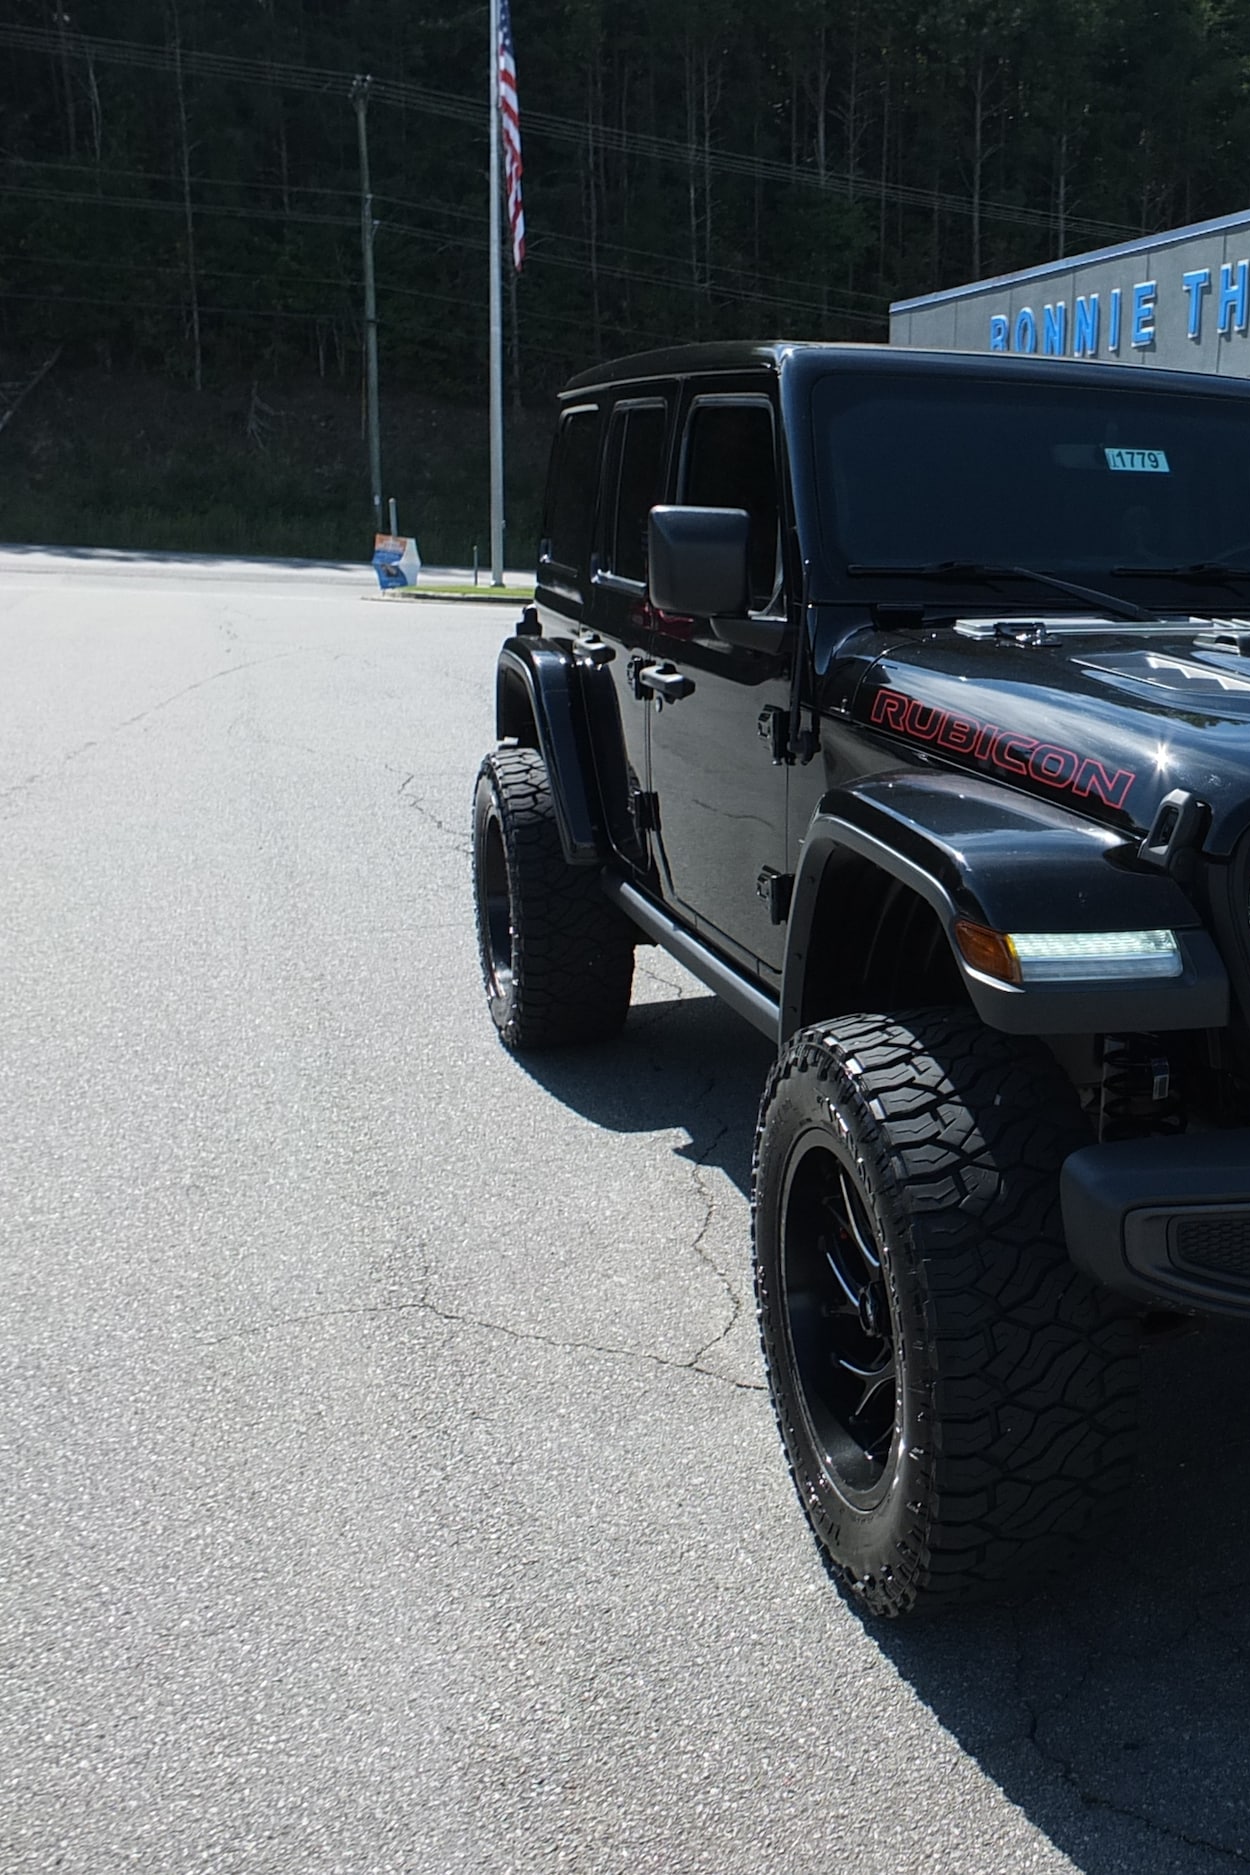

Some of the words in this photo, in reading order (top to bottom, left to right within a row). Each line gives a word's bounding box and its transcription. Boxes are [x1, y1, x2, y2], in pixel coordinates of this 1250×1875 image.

[990, 280, 1157, 356] RONNIE
[1115, 451, 1159, 469] 1779
[870, 690, 1136, 809] RUBICON
